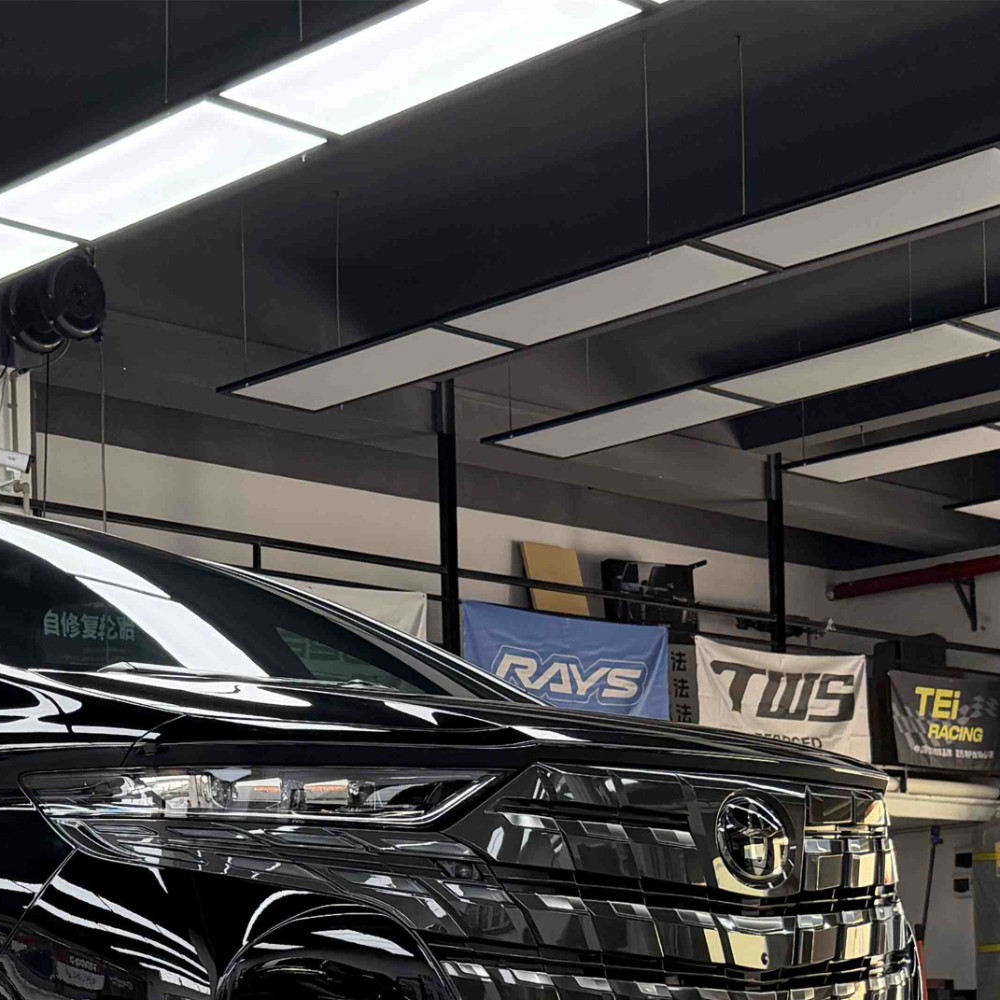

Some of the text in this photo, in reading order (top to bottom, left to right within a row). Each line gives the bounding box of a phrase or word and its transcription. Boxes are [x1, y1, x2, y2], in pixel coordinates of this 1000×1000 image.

[495, 653, 642, 699] RAYS
[710, 660, 856, 723] TWS
[927, 723, 983, 743] RACING
